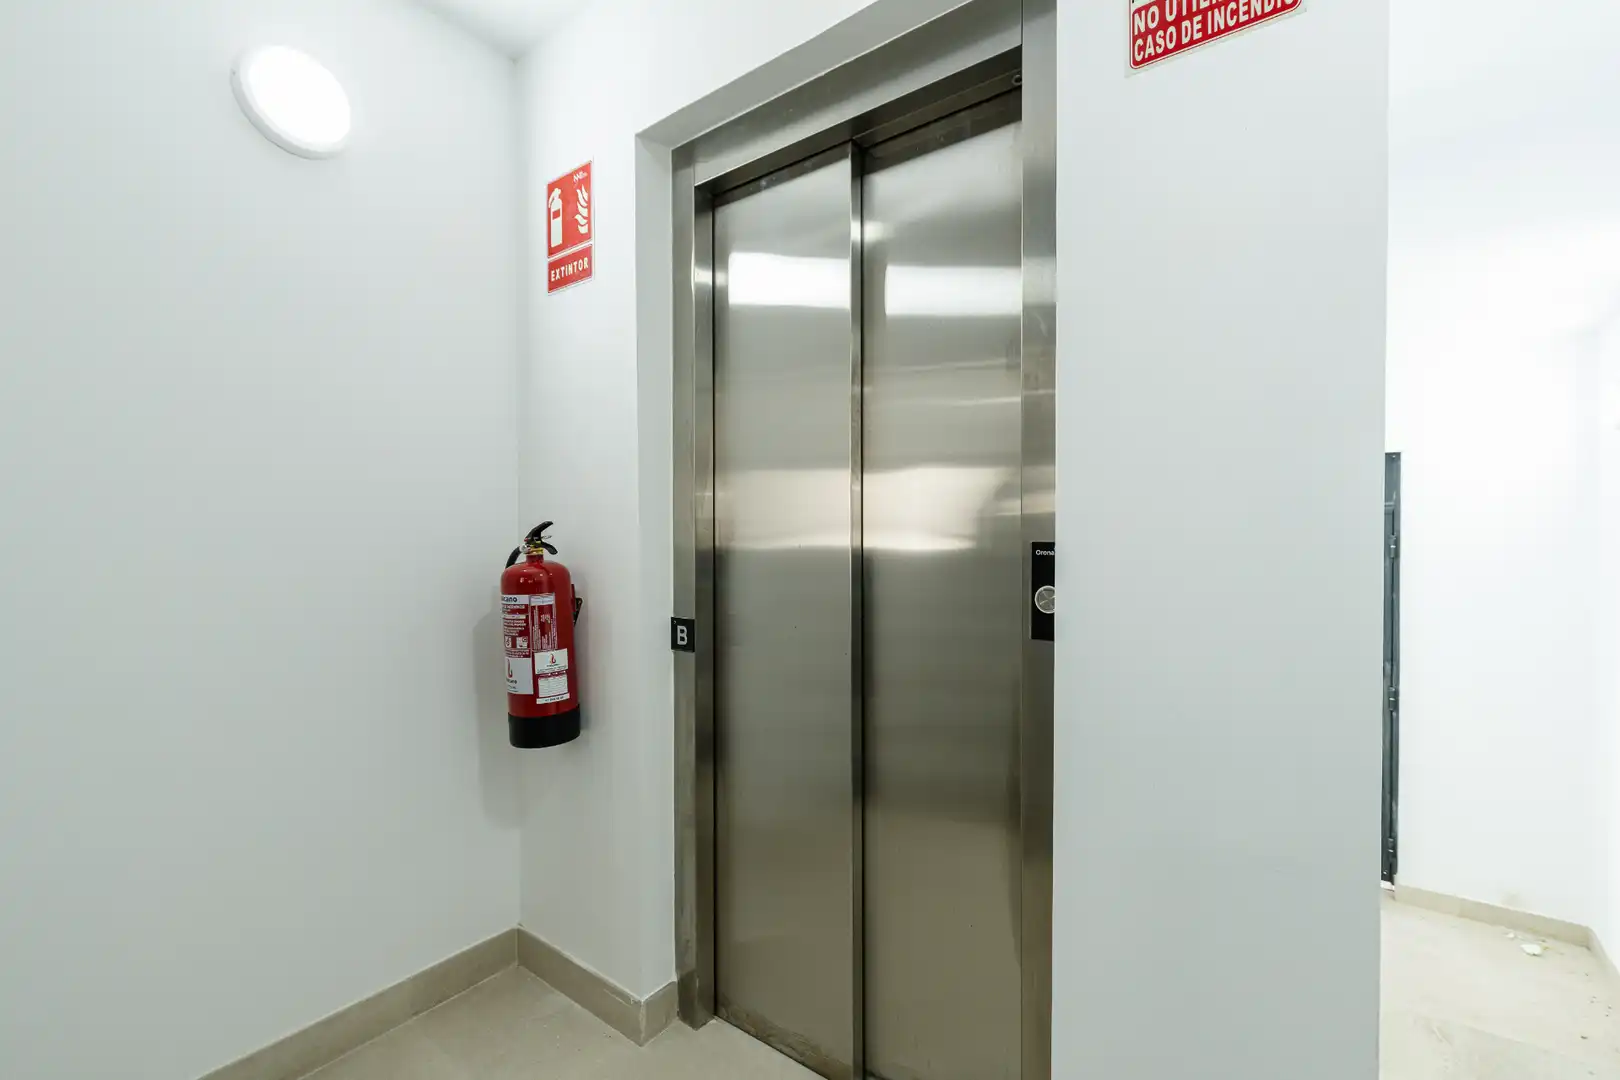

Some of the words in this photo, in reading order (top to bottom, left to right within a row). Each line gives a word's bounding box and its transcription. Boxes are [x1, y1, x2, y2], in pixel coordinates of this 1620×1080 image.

[1133, 5, 1160, 36] NO
[1134, 26, 1177, 62] CASO
[1181, 15, 1203, 45] DE
[1207, 0, 1293, 35] INCEND
[551, 256, 589, 282] EXTINTOR
[677, 625, 688, 646] B
